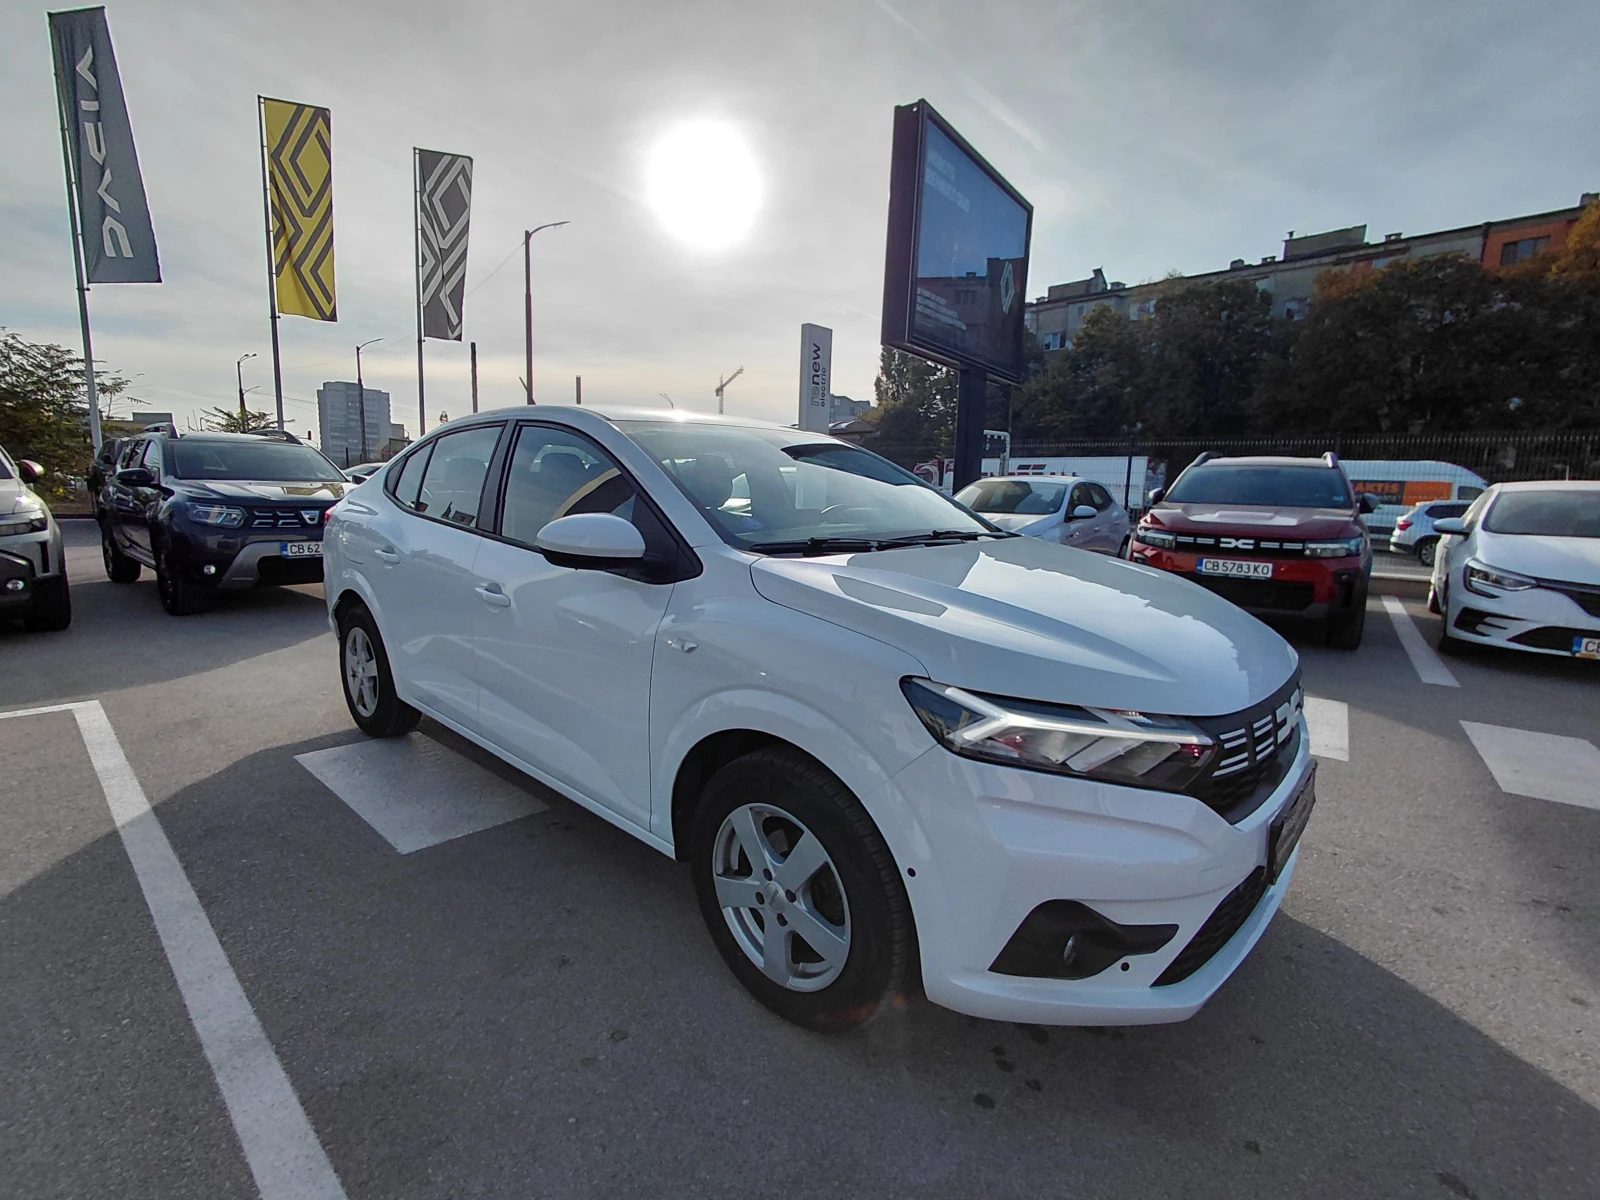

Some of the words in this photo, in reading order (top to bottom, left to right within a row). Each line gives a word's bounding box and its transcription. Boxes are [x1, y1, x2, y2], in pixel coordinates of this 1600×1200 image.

[75, 45, 134, 259] DACIA
[811, 343, 821, 407] renew
[1352, 482, 1400, 493] AKTIS
[307, 543, 323, 553] 62
[1221, 561, 1251, 574] 5783
